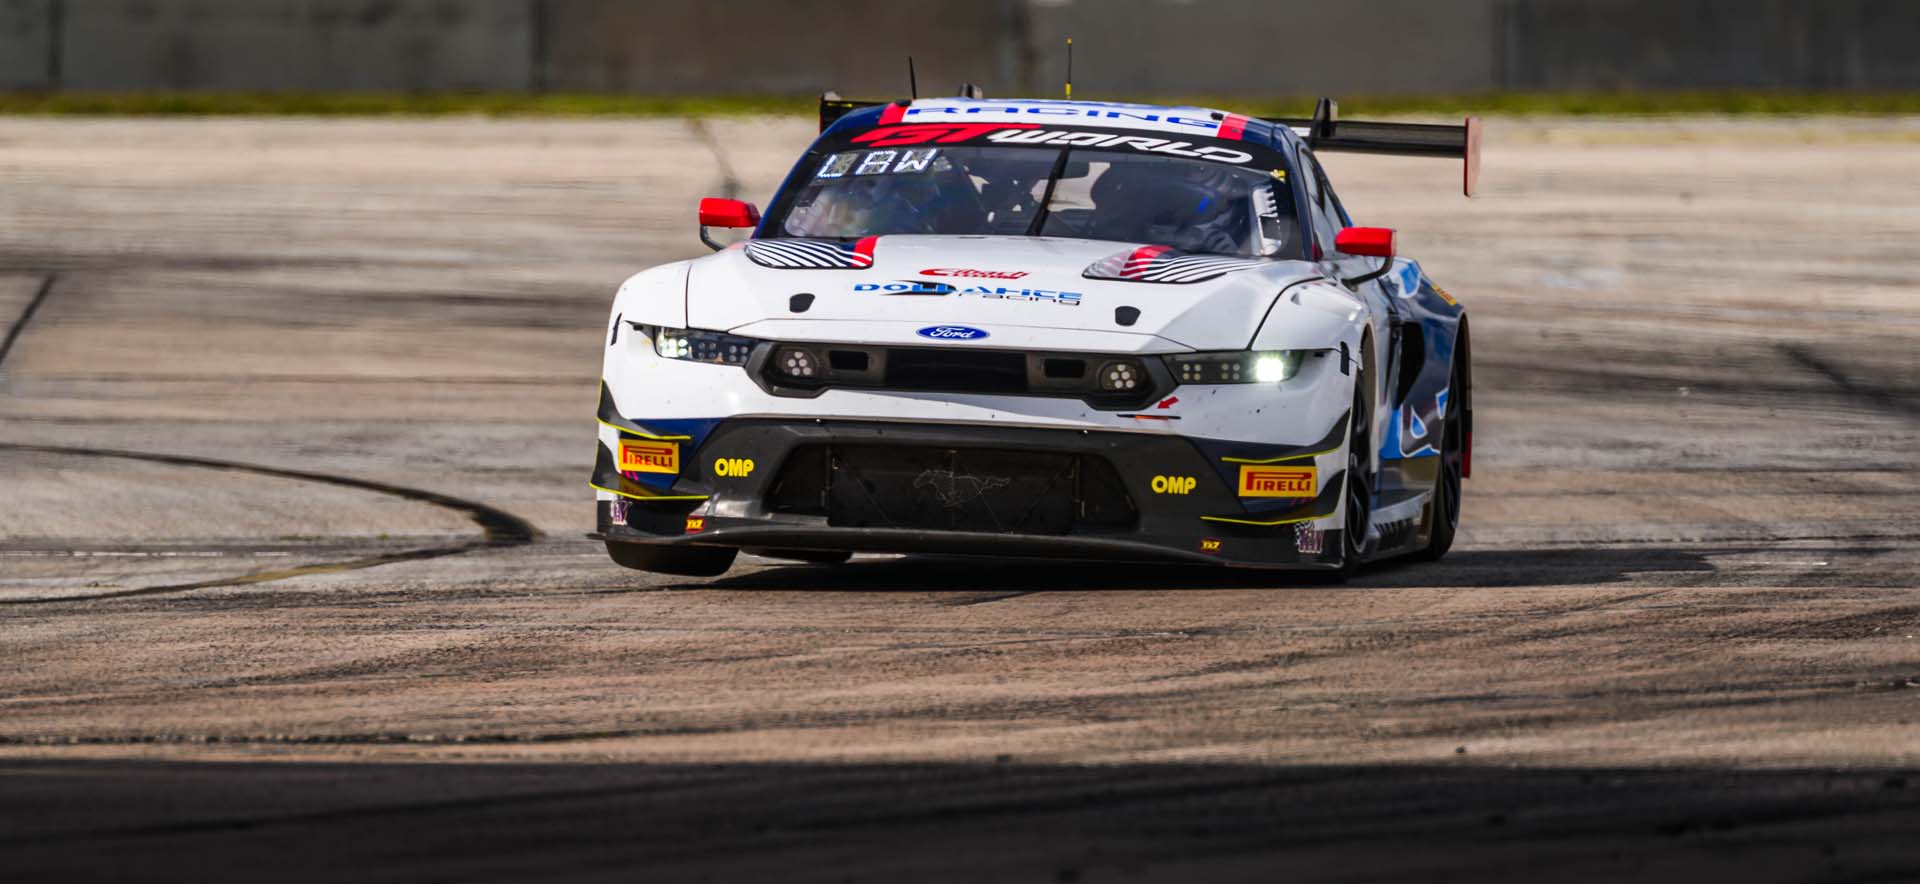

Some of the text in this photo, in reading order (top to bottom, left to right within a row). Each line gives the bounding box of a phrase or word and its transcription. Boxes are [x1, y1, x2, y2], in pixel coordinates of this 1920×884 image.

[907, 106, 1218, 129] RACING
[852, 123, 1254, 164] GT WORLD
[817, 148, 936, 178] LAW
[930, 325, 976, 340] Ford
[623, 445, 673, 468] PIRELLI
[714, 458, 755, 477] OMP
[1151, 475, 1197, 495] OMP
[1246, 471, 1313, 492] PIRELLI
